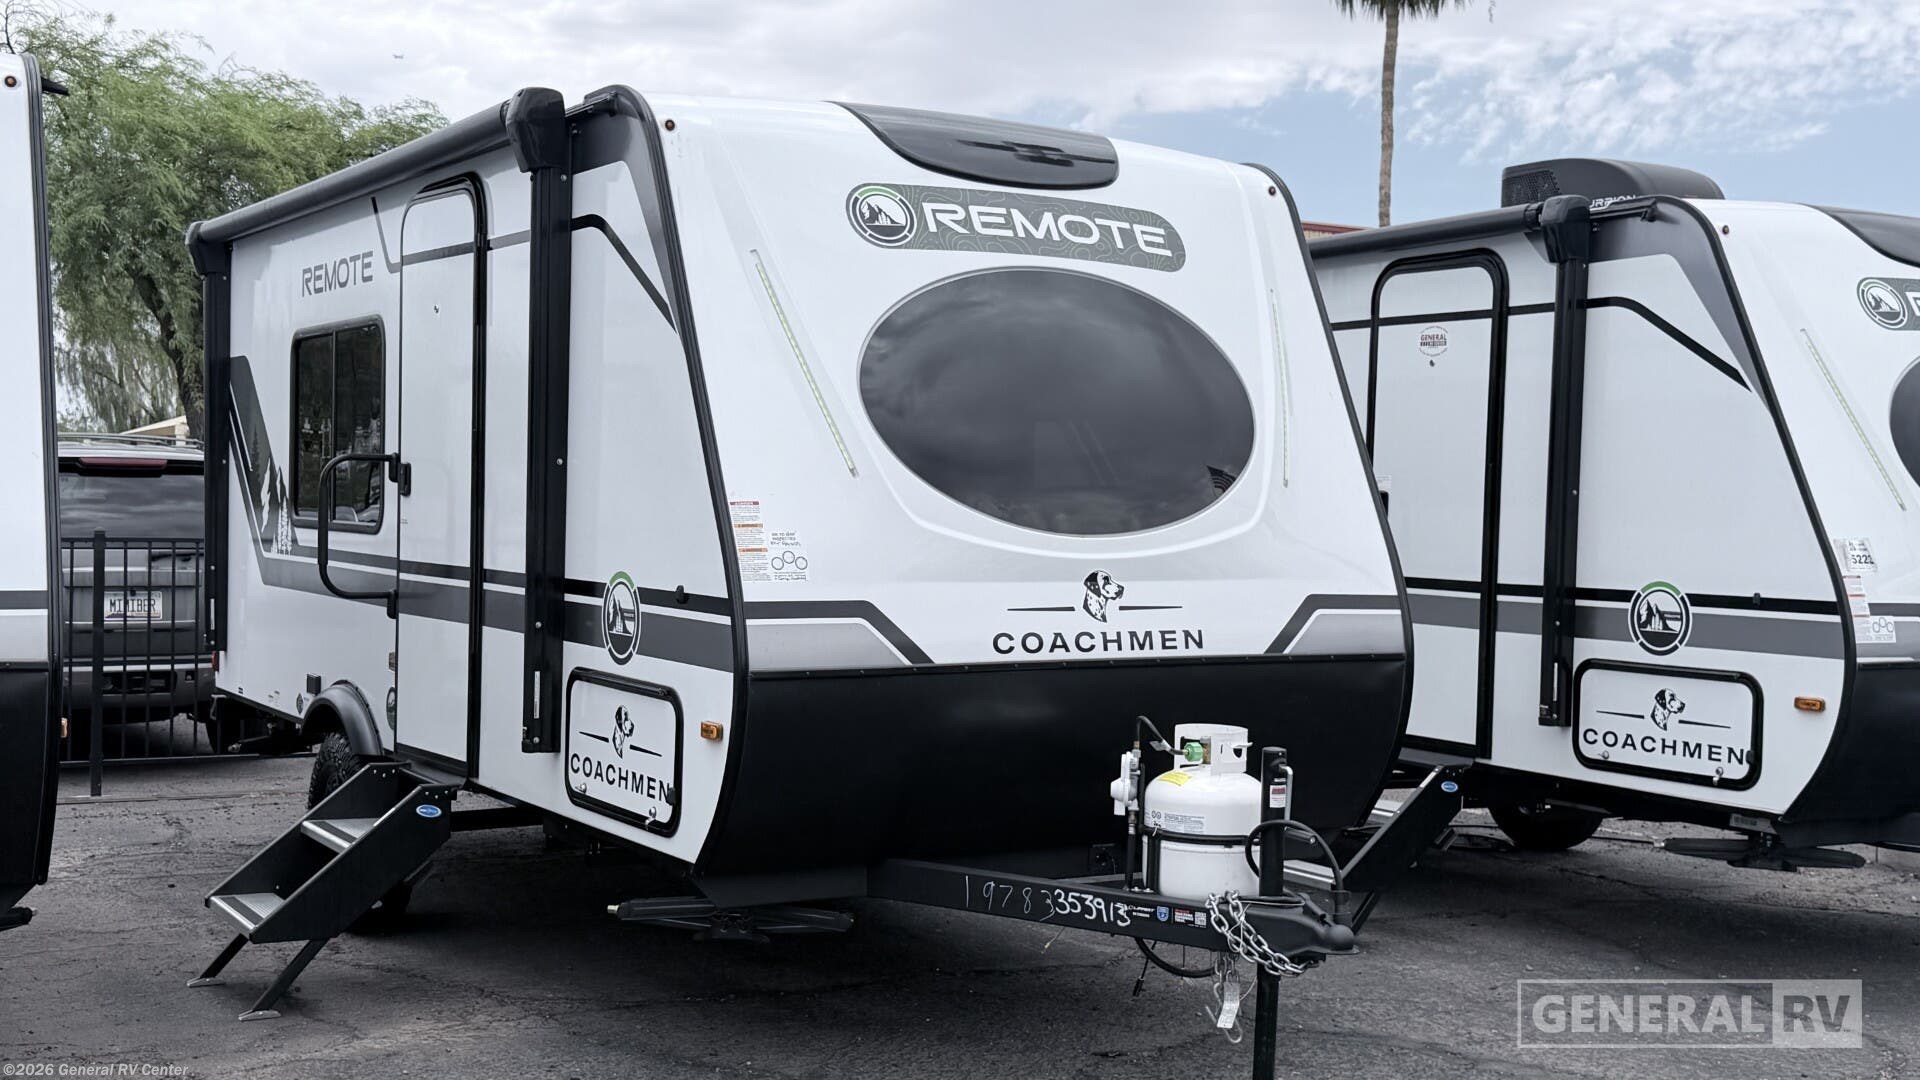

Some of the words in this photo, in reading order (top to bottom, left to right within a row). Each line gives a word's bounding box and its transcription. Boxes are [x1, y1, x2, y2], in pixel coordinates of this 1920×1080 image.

[921, 202, 1172, 257] REMOTE
[302, 250, 374, 297] REMOTE
[1420, 333, 1447, 341] GENERAL
[992, 629, 1204, 655] COACHMEN
[1583, 728, 1744, 766] COACHMEN
[570, 752, 671, 803] COACHMEN
[965, 875, 1055, 921] 19783
